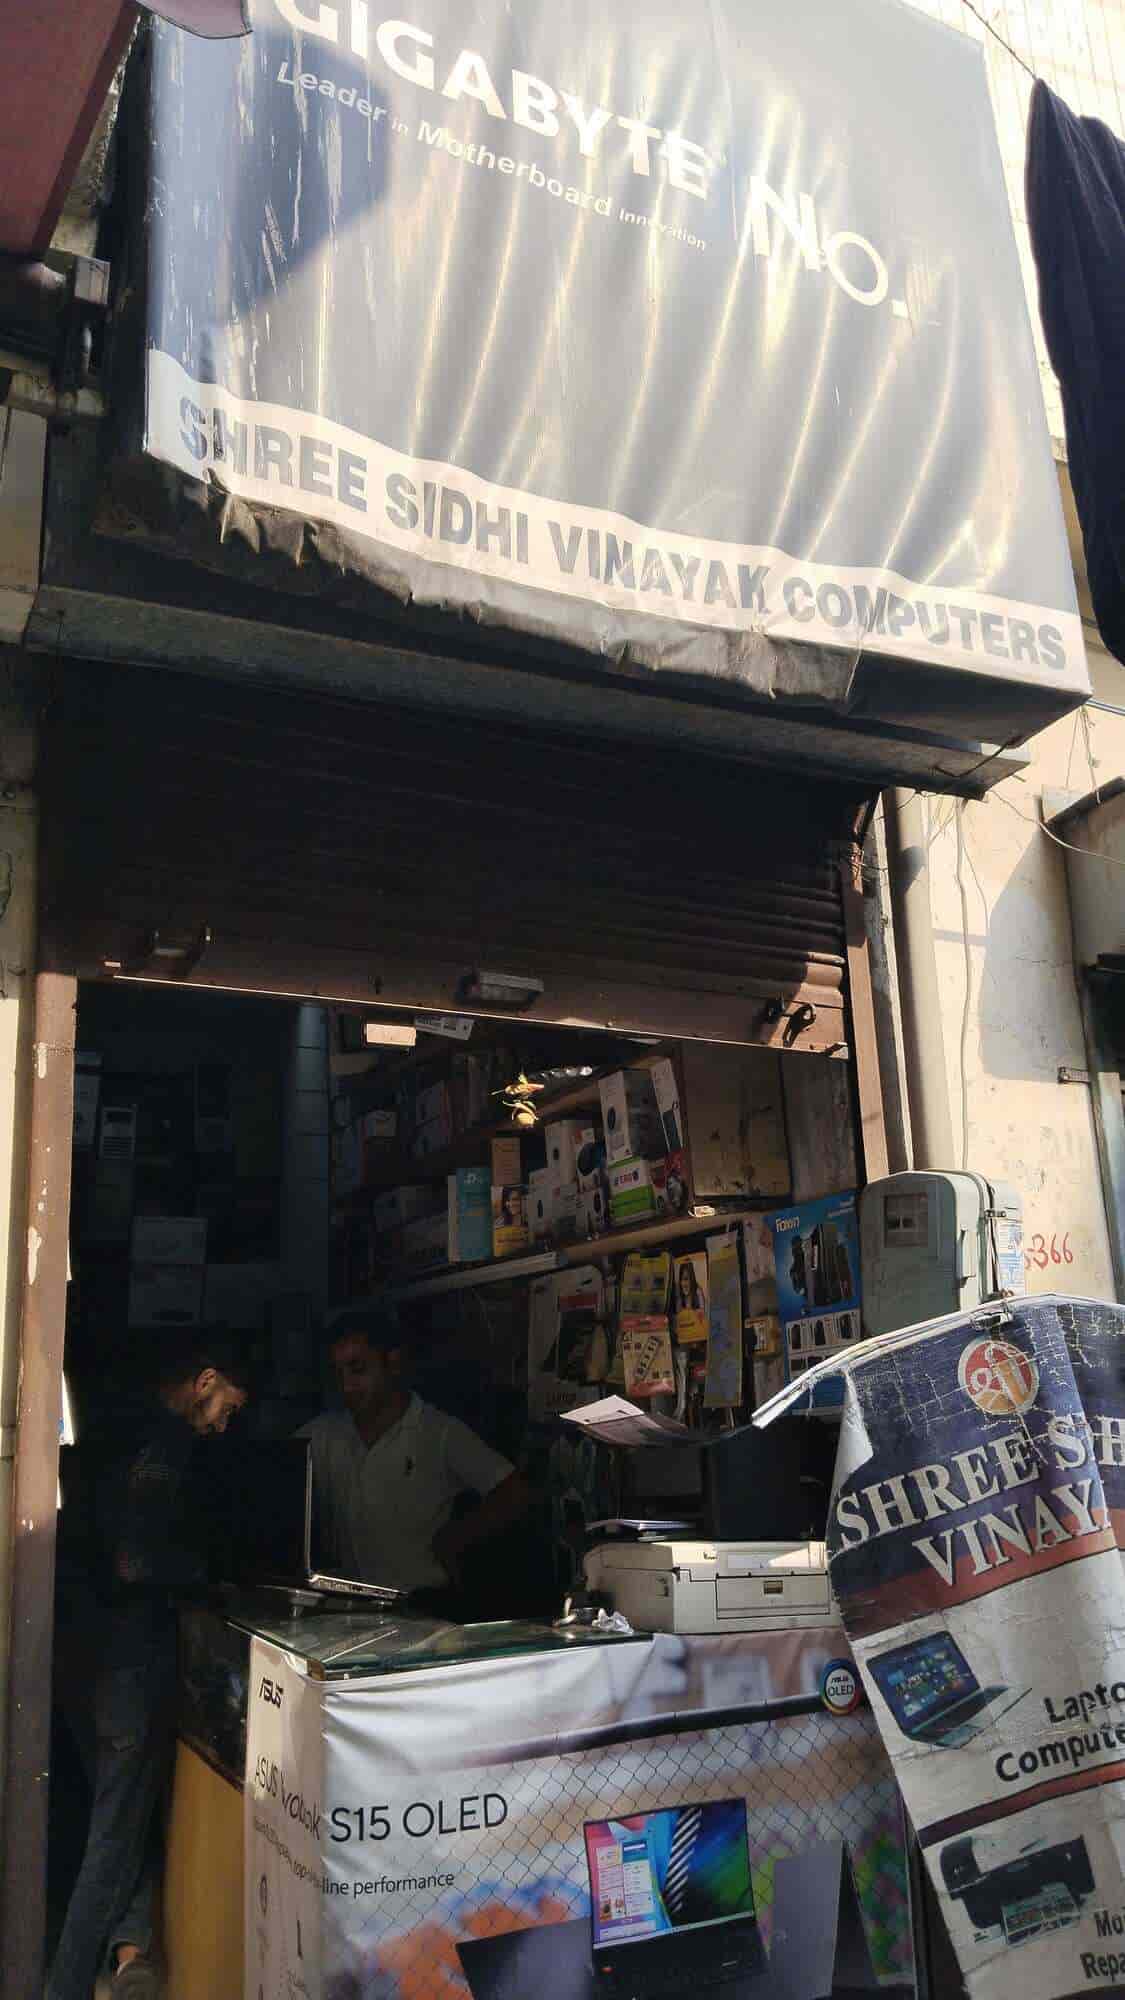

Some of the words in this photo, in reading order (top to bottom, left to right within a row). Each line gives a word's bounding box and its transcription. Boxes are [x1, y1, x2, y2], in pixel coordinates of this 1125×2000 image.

[277, 61, 387, 121] Leader
[391, 115, 410, 135] in
[417, 119, 613, 218] Motherboard
[619, 206, 707, 251] Innovation
[178, 395, 369, 513] SHREE
[384, 472, 530, 566] SIDHI
[546, 520, 771, 613] VINAYAK
[782, 575, 1067, 671] COMPUTERS
[835, 1428, 1040, 1550] SHREE
[827, 1684, 855, 1697] OLED
[1043, 1681, 1125, 1726] Lapto
[329, 1804, 391, 1843] S15
[402, 1792, 509, 1840] OLED
[353, 1872, 456, 1900] performance
[1093, 1907, 1125, 1937] Mo
